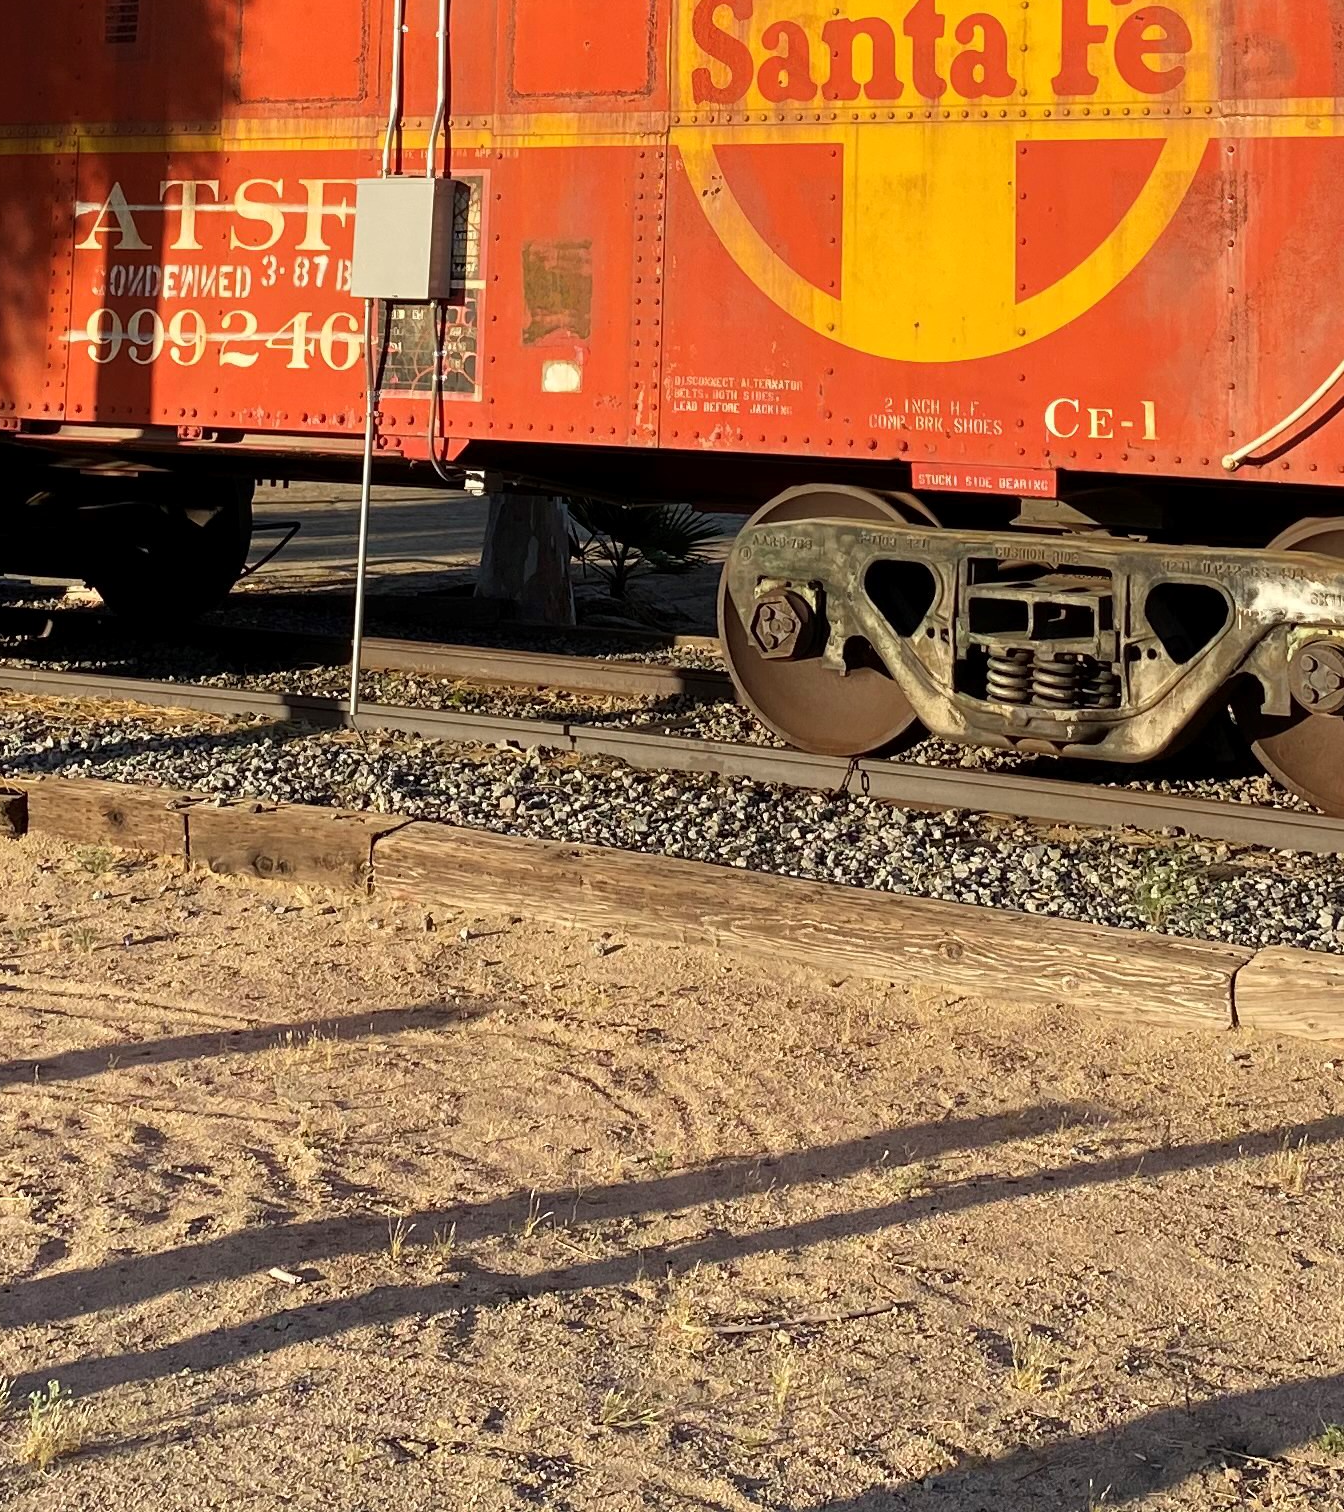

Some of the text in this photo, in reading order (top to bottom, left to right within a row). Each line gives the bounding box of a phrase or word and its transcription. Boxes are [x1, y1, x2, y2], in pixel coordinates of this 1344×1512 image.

[75, 178, 357, 251] ATSF
[87, 308, 359, 371] 999246
[740, 377, 804, 391] ALTERNATOR
[884, 396, 894, 413] 2
[904, 397, 941, 415] INCH
[953, 417, 1003, 436] SHOES
[965, 475, 993, 489] SIDE
[999, 477, 1049, 492] BEARING
